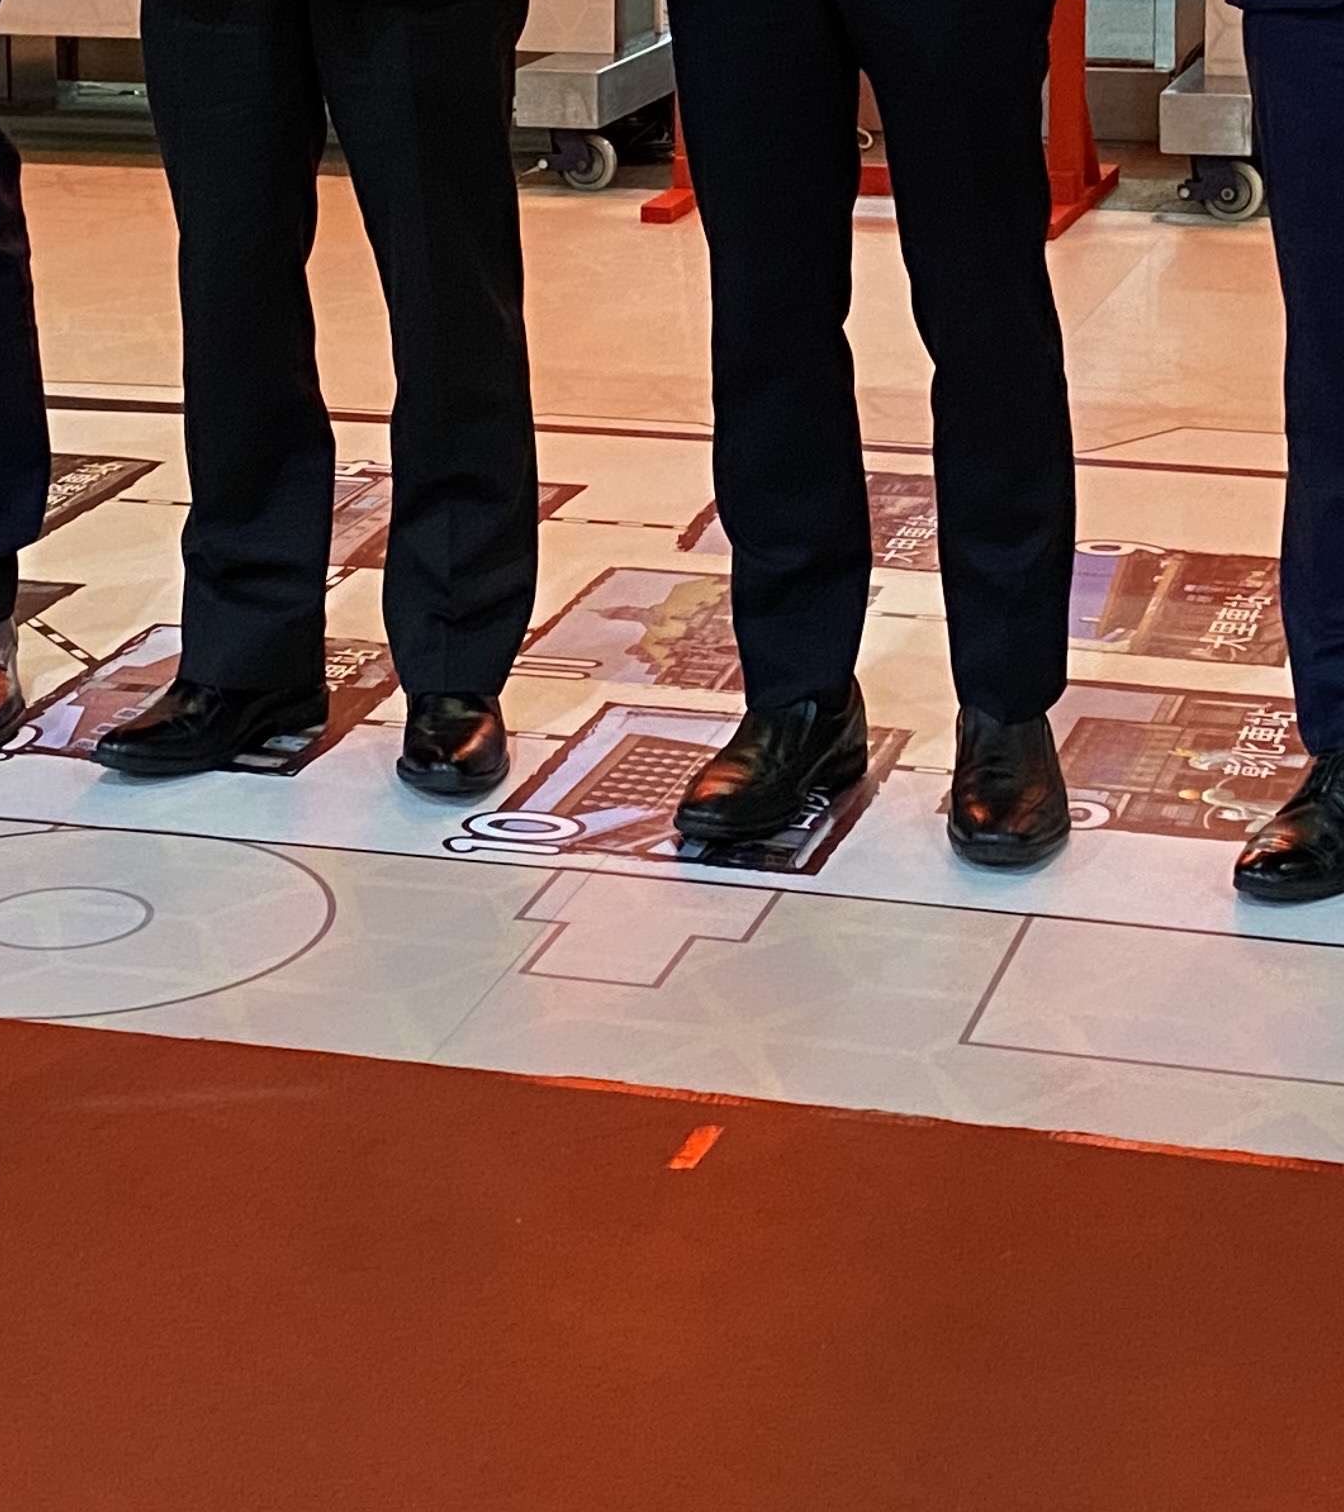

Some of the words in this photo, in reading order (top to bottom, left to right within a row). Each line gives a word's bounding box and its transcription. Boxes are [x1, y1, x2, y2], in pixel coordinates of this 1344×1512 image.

[1196, 592, 1275, 653] 大里車站
[1221, 706, 1298, 780] 彰化車站
